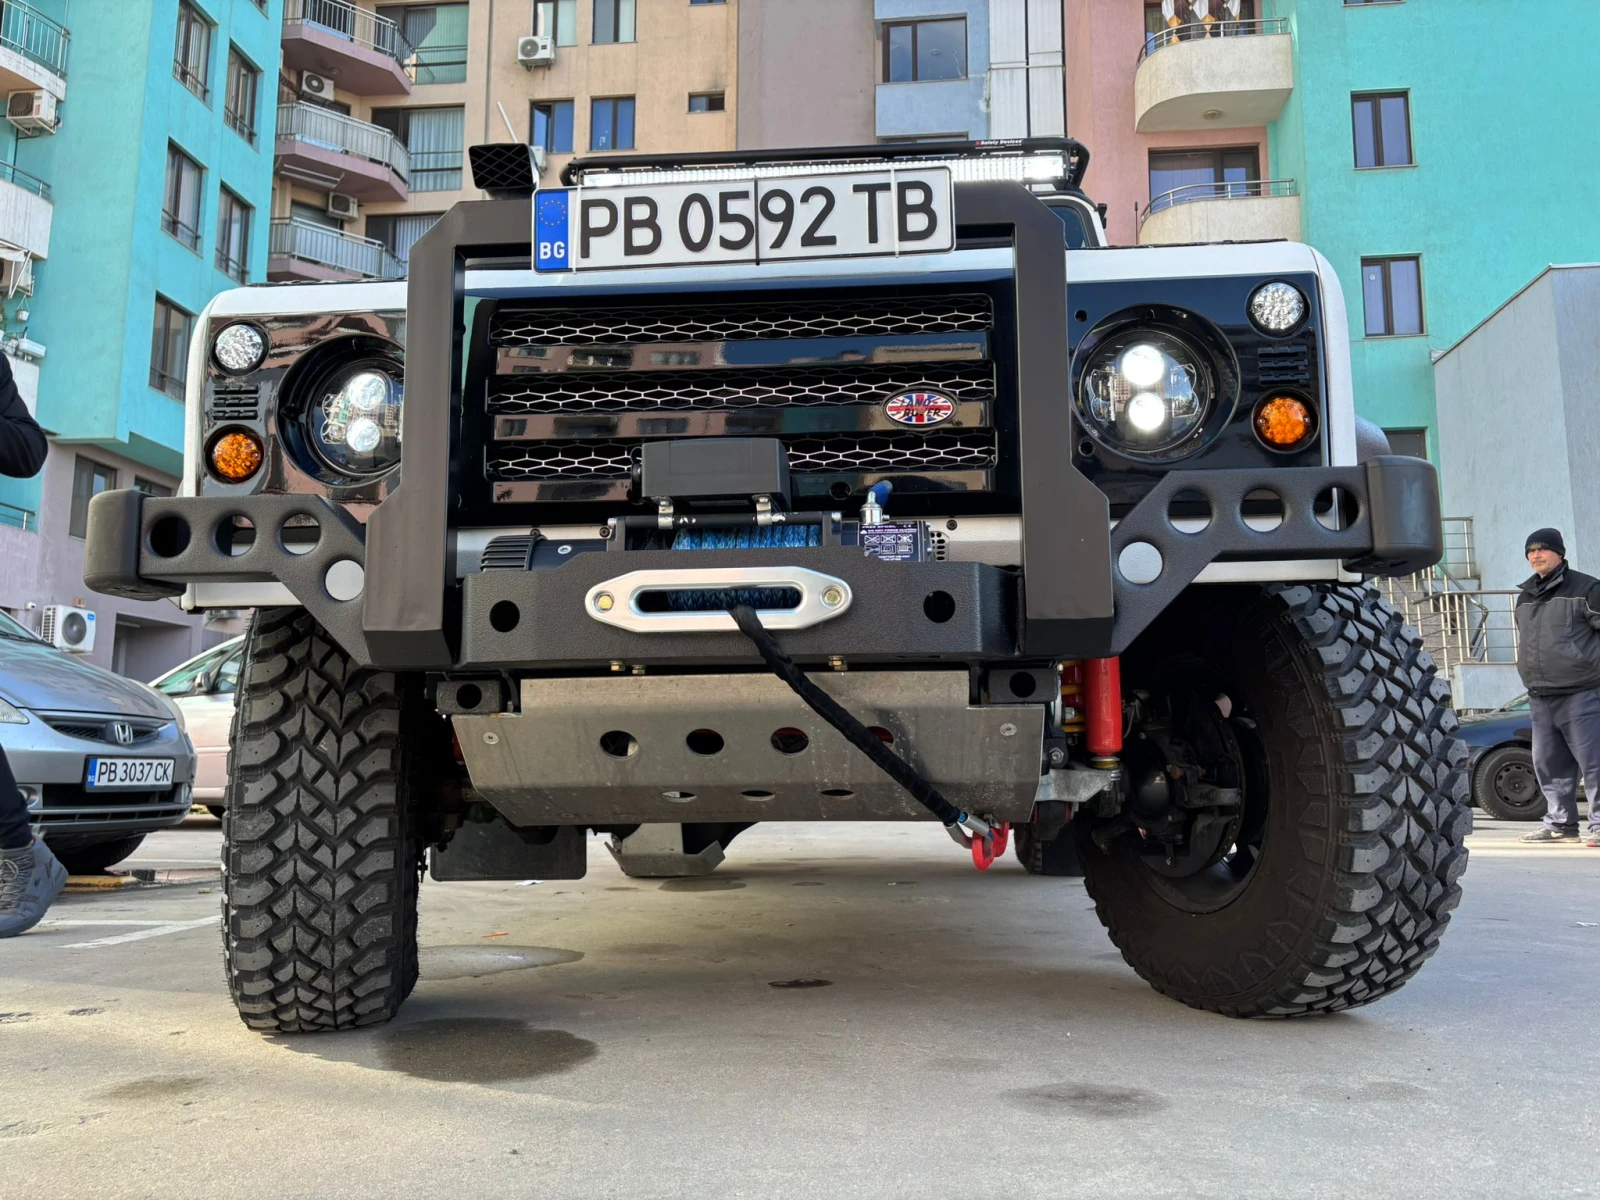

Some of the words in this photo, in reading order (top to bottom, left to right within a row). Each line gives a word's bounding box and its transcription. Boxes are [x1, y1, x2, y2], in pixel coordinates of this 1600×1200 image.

[580, 195, 663, 259] PB
[678, 186, 838, 252] 0592
[852, 180, 939, 244] TB
[539, 242, 566, 259] BG
[97, 762, 117, 782] PB
[120, 762, 153, 782] 3037
[154, 762, 171, 782] CK
